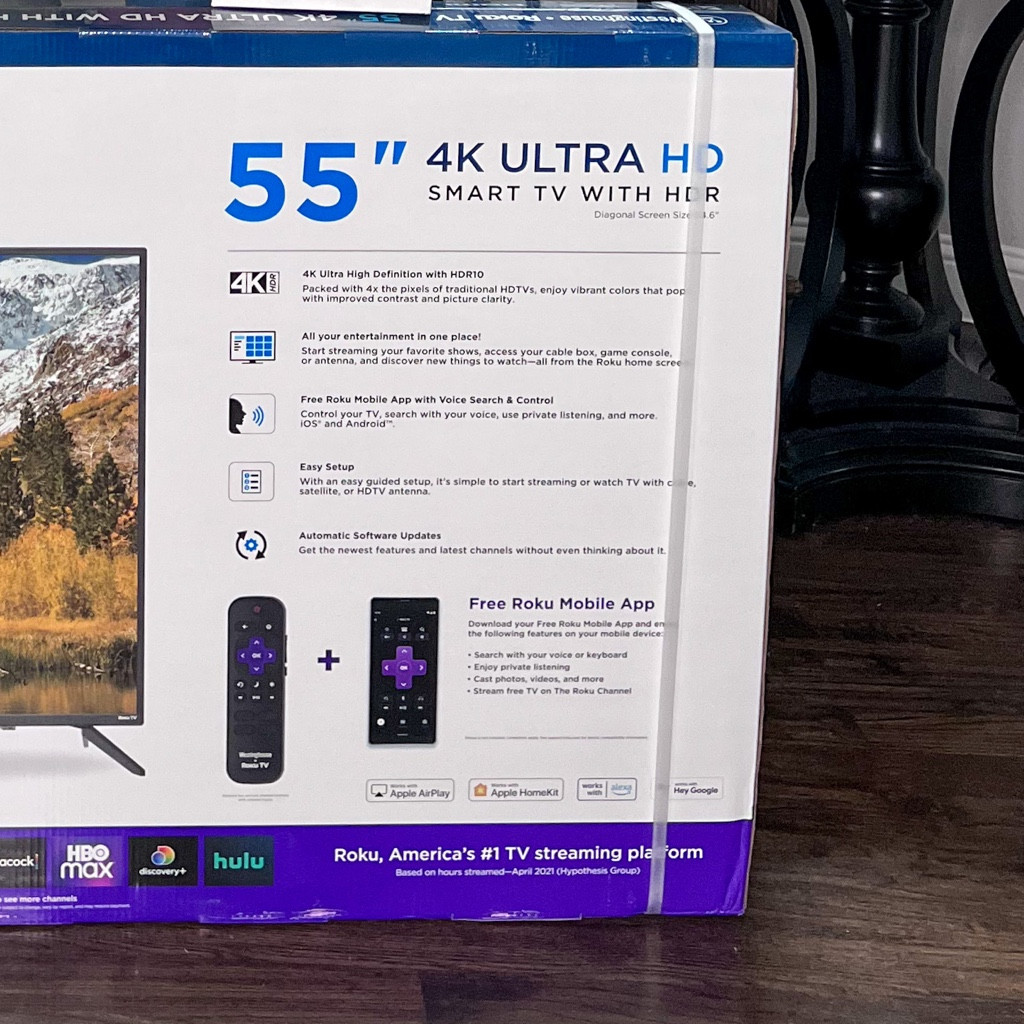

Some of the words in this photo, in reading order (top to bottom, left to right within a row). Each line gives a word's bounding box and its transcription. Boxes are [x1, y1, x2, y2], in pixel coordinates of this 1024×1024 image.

[21, 13, 110, 21] WITH
[120, 13, 167, 21] HD
[177, 13, 284, 22] ULTRA
[297, 13, 337, 22] 4K
[436, 14, 472, 22] TV
[426, 142, 484, 172] 4K
[501, 142, 644, 172] ULTRA
[662, 143, 724, 174] HD
[224, 140, 407, 223] 55"
[428, 184, 520, 201] SMART
[533, 185, 566, 201] TV
[580, 185, 650, 202] WITH
[665, 185, 720, 202] HDR
[593, 209, 636, 221] Diagonal
[638, 210, 671, 219] Screen
[302, 269, 316, 278] 4K
[319, 269, 343, 278] Ultra
[346, 269, 369, 279] High
[373, 269, 422, 278] Definition
[425, 270, 447, 278] with
[450, 270, 484, 278] HDR10
[230, 271, 266, 294] 4K
[269, 273, 277, 293] HDR
[302, 284, 338, 293] Packed
[341, 284, 363, 293] with
[365, 284, 378, 293] 4x
[381, 284, 398, 293] the
[400, 284, 429, 295] pixels
[432, 284, 443, 294] of
[445, 285, 497, 294] traditional
[499, 285, 536, 296] HDTVs,
[540, 285, 567, 296] enjoy
[570, 285, 606, 294] vibrant
[608, 286, 640, 294] colors
[642, 286, 663, 295] that
[666, 288, 686, 297] pop
[302, 294, 323, 302] with
[326, 294, 374, 304] improved
[377, 294, 418, 302] contrast
[421, 294, 440, 302] and
[442, 294, 478, 304] picture
[480, 294, 514, 304] clarity.
[301, 332, 315, 340] All
[318, 333, 340, 341] your
[343, 332, 414, 340] entertainment
[417, 332, 426, 340] in
[450, 332, 481, 342] place!
[300, 395, 322, 403] Free
[326, 395, 351, 403] Roku
[354, 395, 387, 403] Mobile
[390, 395, 412, 405] App
[414, 395, 436, 403] with
[438, 395, 466, 404] Voice
[469, 395, 503, 404] Search
[506, 396, 513, 404] &
[516, 396, 553, 404] Control
[300, 462, 322, 472] Easy
[325, 462, 354, 472] Setup
[299, 487, 340, 496] satellite,
[357, 487, 385, 495] HDTV
[388, 487, 430, 495] antenna.
[298, 531, 350, 539] Automatic
[353, 531, 397, 539] Software
[400, 531, 441, 541] Updates
[298, 545, 316, 554] Get
[318, 546, 335, 554] the
[337, 546, 372, 554] newest
[375, 545, 416, 554] features
[418, 545, 437, 554] and
[439, 546, 466, 554] latest
[469, 545, 512, 554] channels
[515, 546, 553, 554] without
[582, 546, 622, 556] thinking
[625, 546, 654, 555] about
[657, 546, 665, 554] it.
[469, 597, 506, 610] Free
[512, 596, 553, 610] Roku
[559, 596, 614, 610] Mobile
[620, 597, 654, 612] App
[389, 789, 417, 799] Apple
[419, 788, 451, 799] AirPlay
[490, 788, 518, 798] Apple
[519, 788, 559, 797] HomeKit
[674, 786, 689, 795] Hey
[690, 786, 719, 795] Google
[66, 844, 110, 862] HBO
[334, 847, 383, 864] Roku,
[388, 846, 475, 862] America's
[480, 846, 499, 860] #1
[504, 846, 530, 860] TV
[534, 845, 622, 863] streaming
[628, 844, 704, 862] plaorm
[213, 852, 265, 870] hulu
[60, 861, 114, 879] max
[395, 868, 423, 876] Based
[437, 867, 462, 876] hours
[463, 867, 533, 876] streamed—April
[533, 867, 554, 875] 2021
[555, 866, 608, 876] (Hypothesis
[609, 866, 641, 875] Group)
